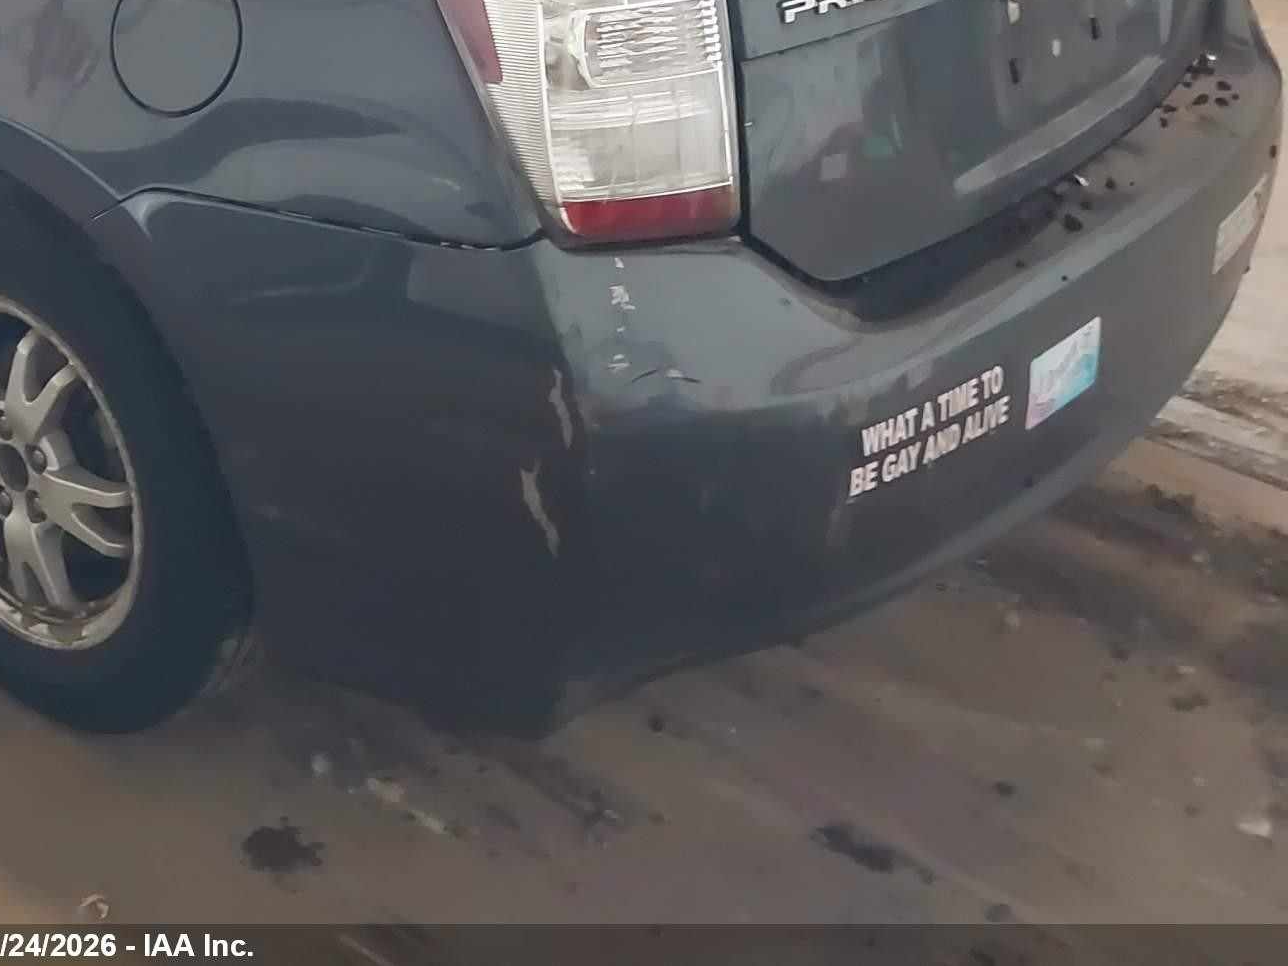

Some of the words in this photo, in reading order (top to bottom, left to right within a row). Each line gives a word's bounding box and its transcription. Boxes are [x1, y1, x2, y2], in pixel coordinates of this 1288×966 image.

[849, 461, 880, 498] BE
[881, 441, 923, 483] GAY
[922, 423, 963, 465] AND
[962, 395, 1012, 444] ALIVE
[862, 408, 919, 457] WHAT
[921, 401, 936, 432] A
[937, 378, 980, 422] TIME
[981, 365, 1005, 400] TO
